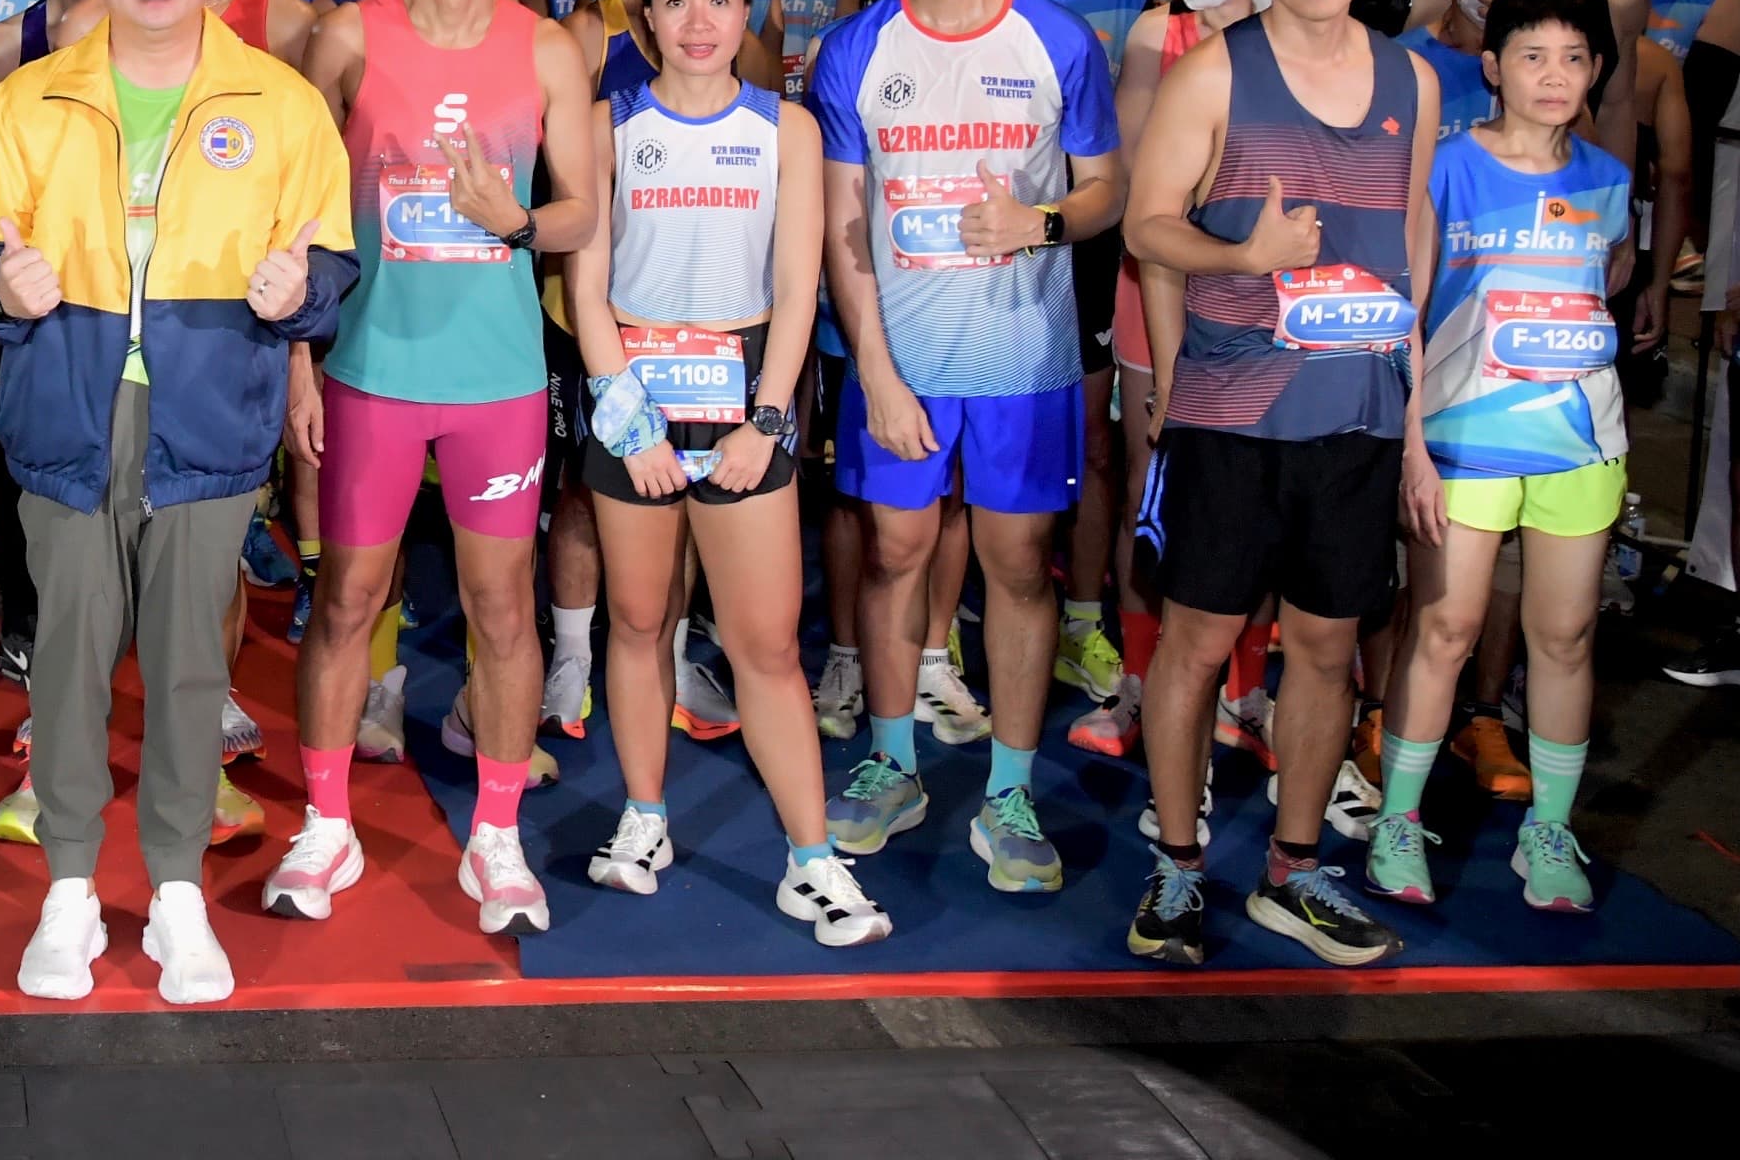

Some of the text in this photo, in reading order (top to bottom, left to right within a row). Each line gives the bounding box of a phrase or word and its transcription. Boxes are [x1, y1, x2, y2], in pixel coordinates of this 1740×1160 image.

[980, 75, 1036, 89] B2R RUNNER
[986, 88, 1033, 100] ATHLETICS
[877, 122, 1042, 153] B2RACADEMY
[711, 145, 761, 156] B2R RUNNER
[715, 156, 757, 167] ATHLETICS
[631, 186, 760, 210] B2RACADEMY
[1447, 228, 1508, 252] Thai
[1514, 230, 1575, 250] Sikh
[1300, 301, 1400, 326] M-1377
[1512, 327, 1605, 351] F-1260
[641, 363, 729, 385] F-1108
[549, 372, 568, 438] NIKE PRO
